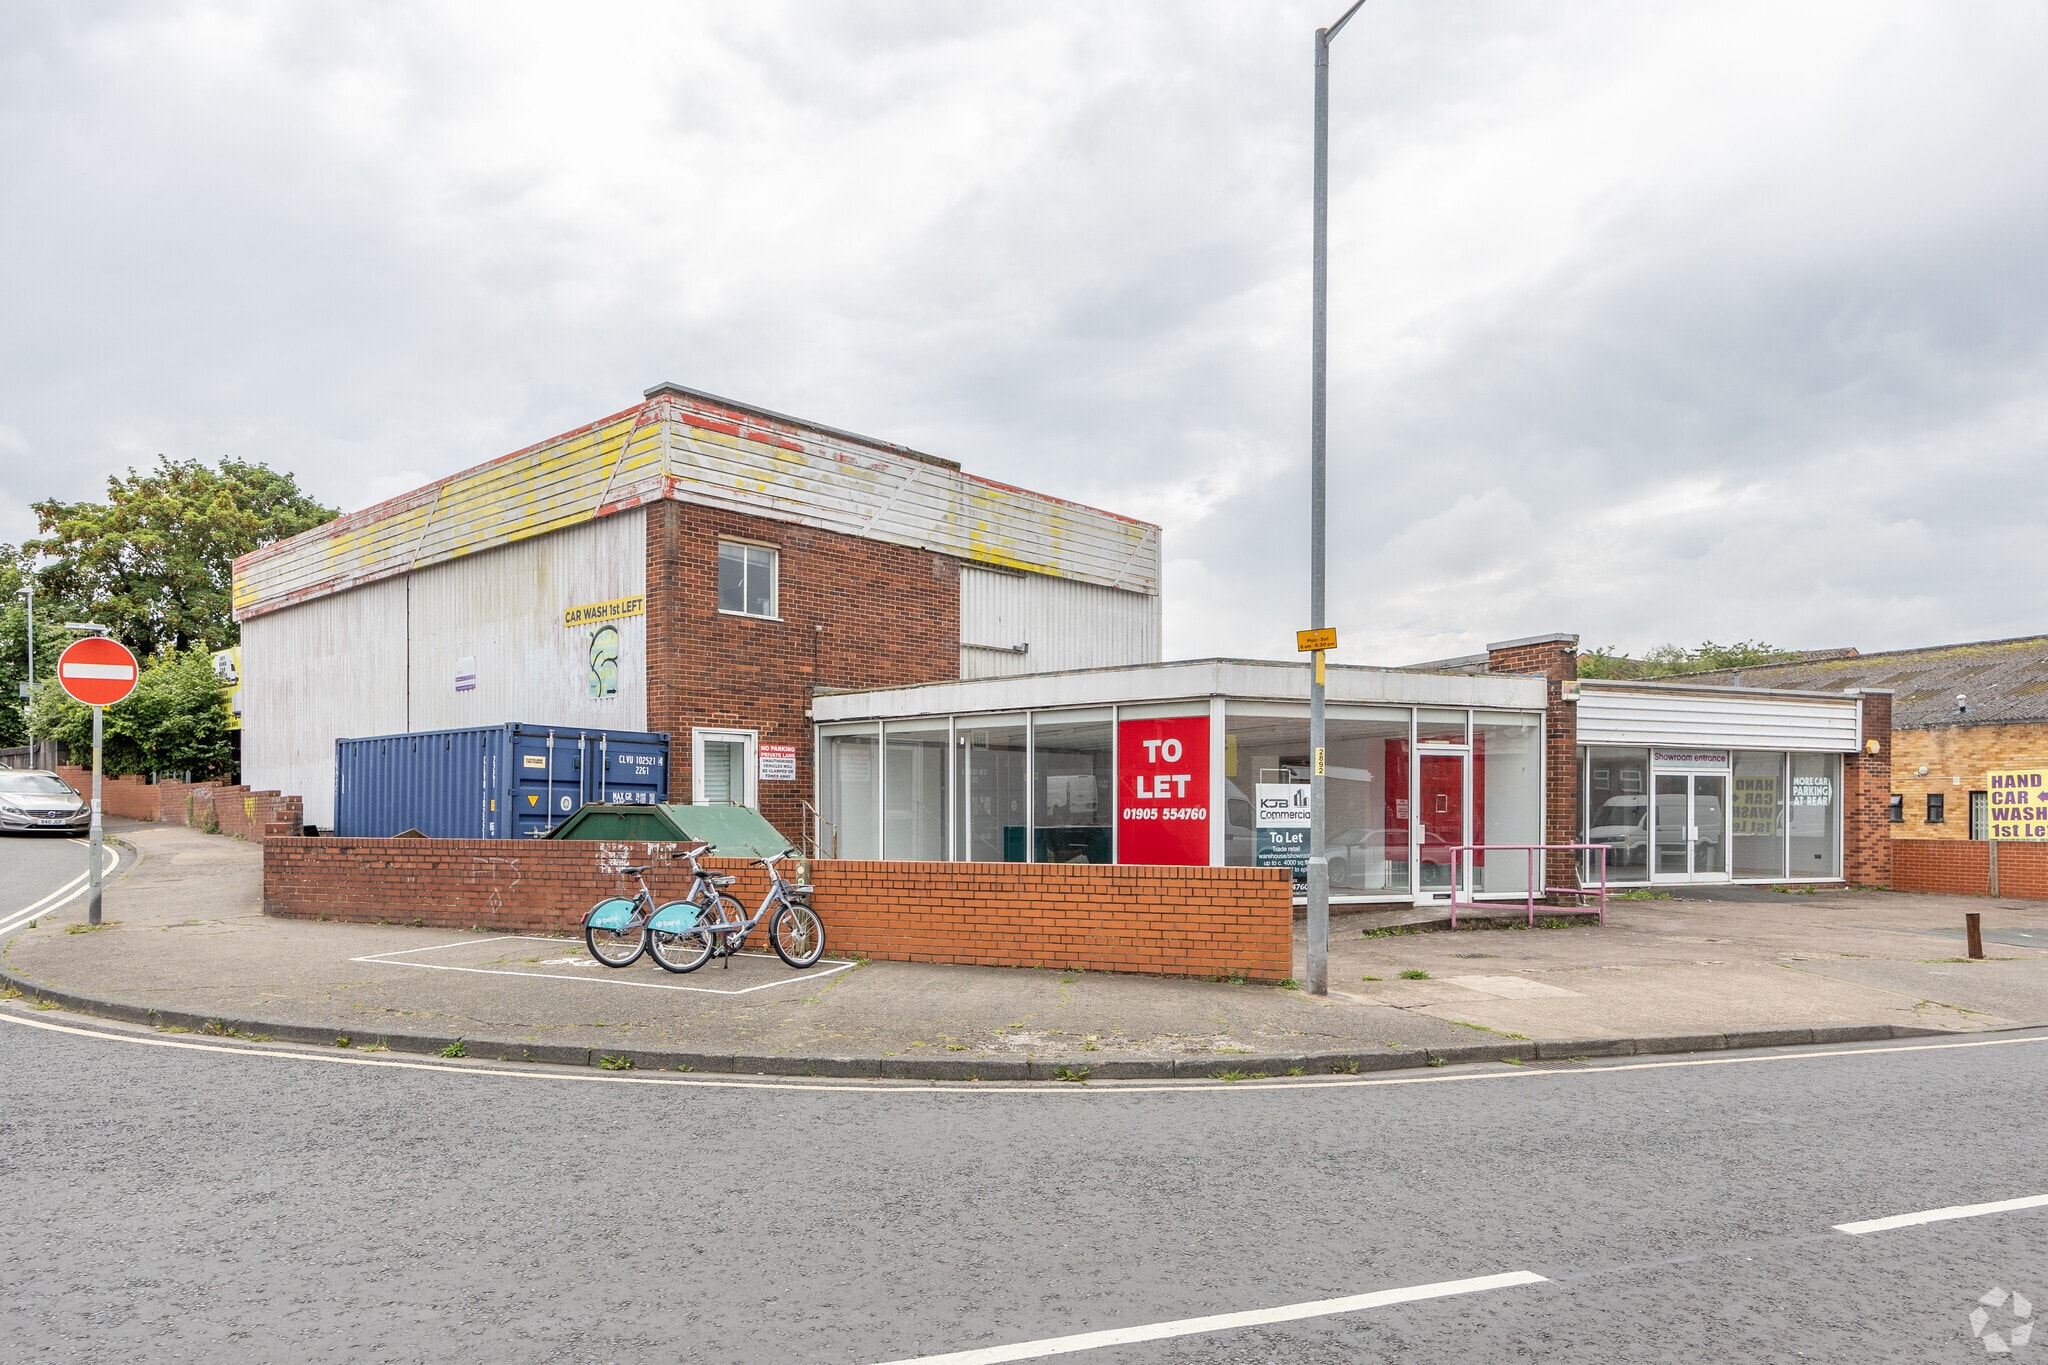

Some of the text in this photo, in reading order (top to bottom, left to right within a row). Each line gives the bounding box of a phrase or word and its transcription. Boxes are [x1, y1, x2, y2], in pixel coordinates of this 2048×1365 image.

[565, 599, 643, 623] CAR WASH 1st LEFT
[1143, 738, 1183, 763] TO
[636, 756, 656, 766] 102521
[1654, 752, 1726, 762] Showroom entrance
[1137, 774, 1191, 798] LET
[1793, 777, 1828, 786] MORE CAR
[1992, 774, 2042, 788] HAND
[1793, 786, 1828, 796] PARKING
[1260, 798, 1289, 809] KJB
[1793, 796, 1828, 806] AT REAR
[1992, 791, 2028, 804] CAR
[1123, 807, 1207, 820] 01905 554760
[1260, 810, 1311, 820] Commercia
[1991, 806, 2047, 821] WASH
[1991, 823, 2048, 837] 1st Le
[1269, 831, 1304, 843] To Let
